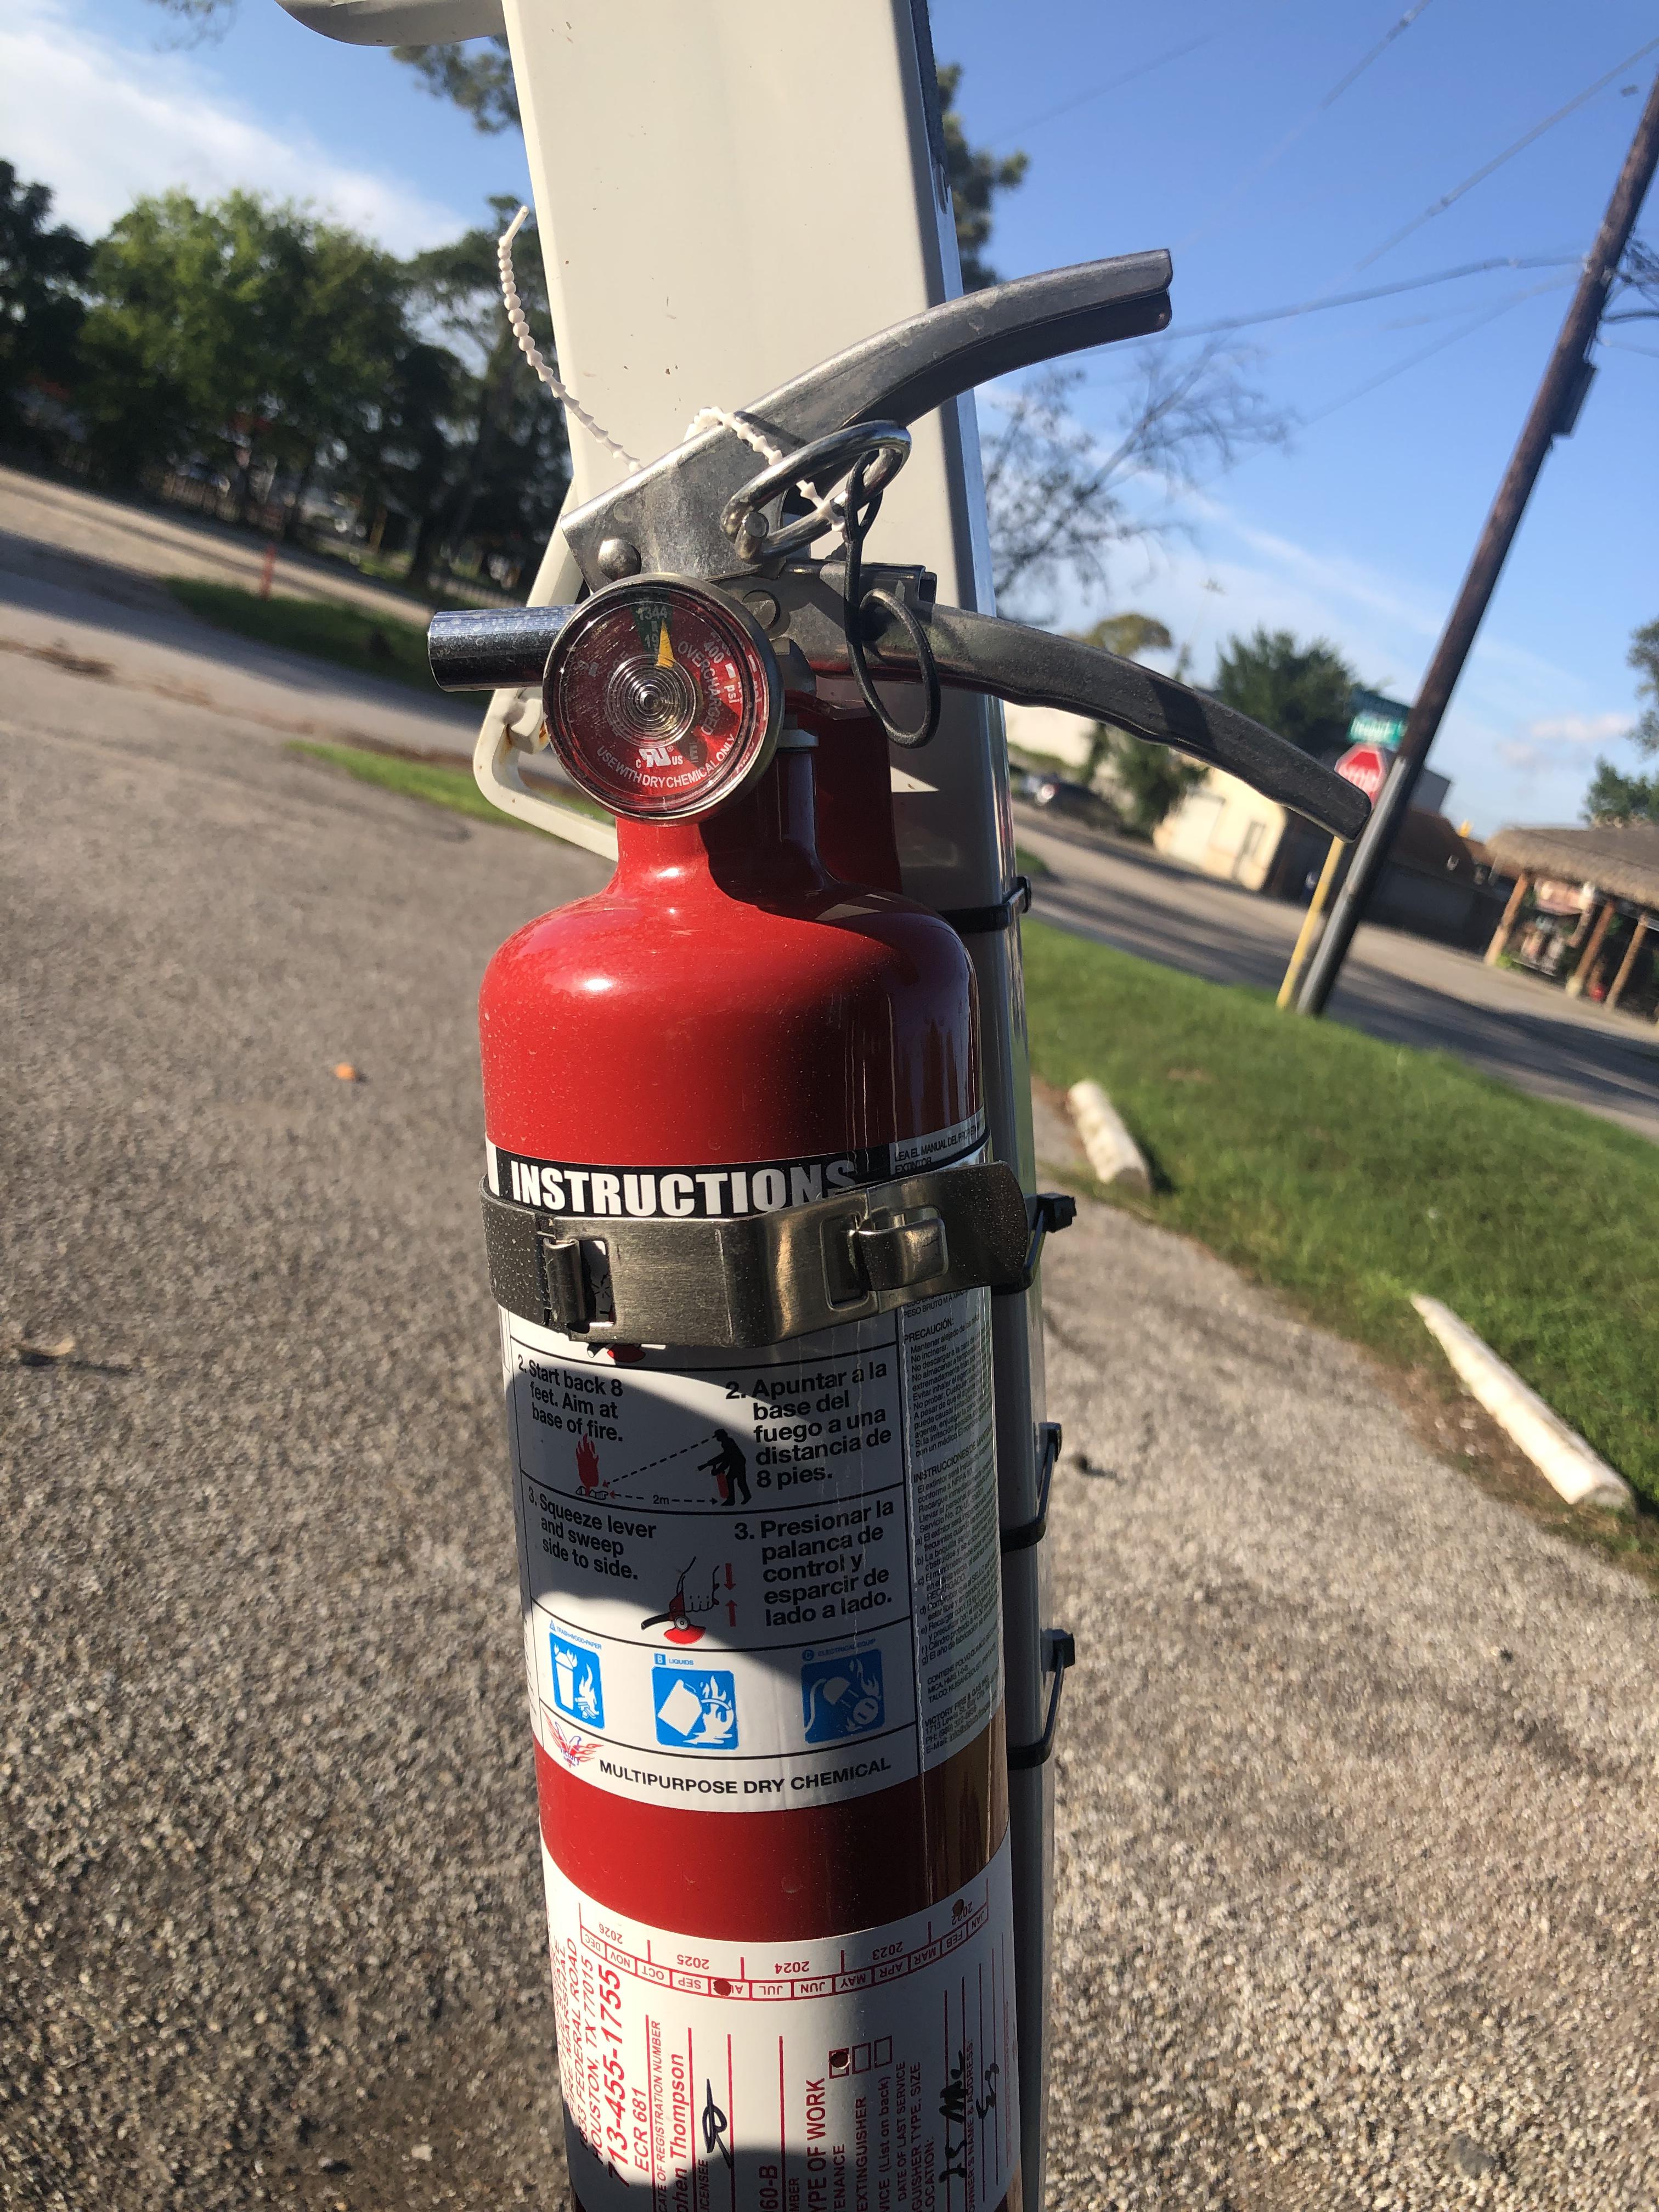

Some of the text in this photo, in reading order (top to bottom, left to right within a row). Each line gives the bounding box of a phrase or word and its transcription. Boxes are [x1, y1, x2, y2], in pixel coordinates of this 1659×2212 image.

[703, 640, 724, 664] 400
[678, 640, 721, 736] OVERCHARGED
[723, 684, 739, 705] psi
[597, 746, 618, 769] USE
[616, 764, 642, 783] WITH
[642, 774, 666, 788] DRY
[666, 760, 719, 788] CHEMICAL
[715, 733, 735, 761] ONLY
[911, 1147, 921, 1158] EL
[921, 1139, 947, 1155] MANUAL
[948, 1135, 958, 1146] DEL
[510, 1158, 856, 1217] INSTRUCTIONS
[518, 1354, 624, 1397] 2. Start back 8
[911, 1355, 921, 1364] No
[912, 1364, 921, 1373] No
[725, 1362, 887, 1400] 2. Apuntar a la
[912, 1375, 922, 1383] No
[913, 1387, 932, 1401] Evitar
[530, 1381, 618, 1419] feet. Aim at
[753, 1390, 849, 1420] base del
[913, 1402, 923, 1410] No
[532, 1402, 624, 1442] base of fire.
[753, 1408, 886, 1443] fuego a una
[914, 1412, 919, 1421] A
[755, 1429, 892, 1465] distancia de
[757, 1466, 833, 1490] 8 pies.
[528, 1486, 657, 1538] 3. Squeeze lever
[653, 1494, 670, 1504] 2m
[734, 1500, 894, 1541] 3. Presionar la
[541, 1518, 624, 1558] and sweep
[761, 1526, 884, 1565] palanca de
[543, 1537, 638, 1580] side to side.
[763, 1553, 863, 1583] control y
[764, 1567, 889, 1605] esparcir de
[766, 1592, 893, 1627] lado a lado.
[657, 1655, 663, 1664] B
[599, 1757, 891, 1795] MULTIPURPOSE DRY CHEMICAL
[599, 1922, 623, 1945] 2026
[970, 1911, 986, 1928] JAN
[585, 1933, 601, 1952] DEC
[872, 1942, 903, 1961] 2023
[914, 1947, 936, 1965] MAR
[946, 1932, 963, 1949] FEB
[567, 1937, 580, 2002] ROAD
[611, 1951, 631, 1968] NOV
[641, 1965, 664, 1980] OCT
[677, 1954, 710, 1970] 2025
[775, 1961, 809, 1974] 2024
[879, 1963, 904, 1978] APR
[678, 1977, 701, 1989] SEP
[761, 1985, 783, 1995] JUL
[800, 1981, 826, 1994] JUN
[840, 1976, 866, 1988] MAY
[573, 2008, 585, 2103] FEDERAL
[581, 1954, 603, 2165] HOUSTON, TX 77015
[652, 2020, 662, 2072] NUMBER
[598, 1963, 630, 2188] 713-455-1755
[910, 2061, 921, 2095] SIZE
[652, 2074, 667, 2164] REGISTRATION
[669, 2053, 690, 2159] Thompson
[806, 2078, 826, 2141] WORK
[632, 2087, 650, 2172] ECR 681
[876, 2075, 892, 2172] (List on back)
[895, 2061, 907, 2202] DATE OF LAST SERVICE
[966, 2118, 975, 2153] NAME
[807, 2146, 827, 2172] OF
[855, 2097, 868, 2212] EXTINGUISHER
[657, 2166, 667, 2182] OF
